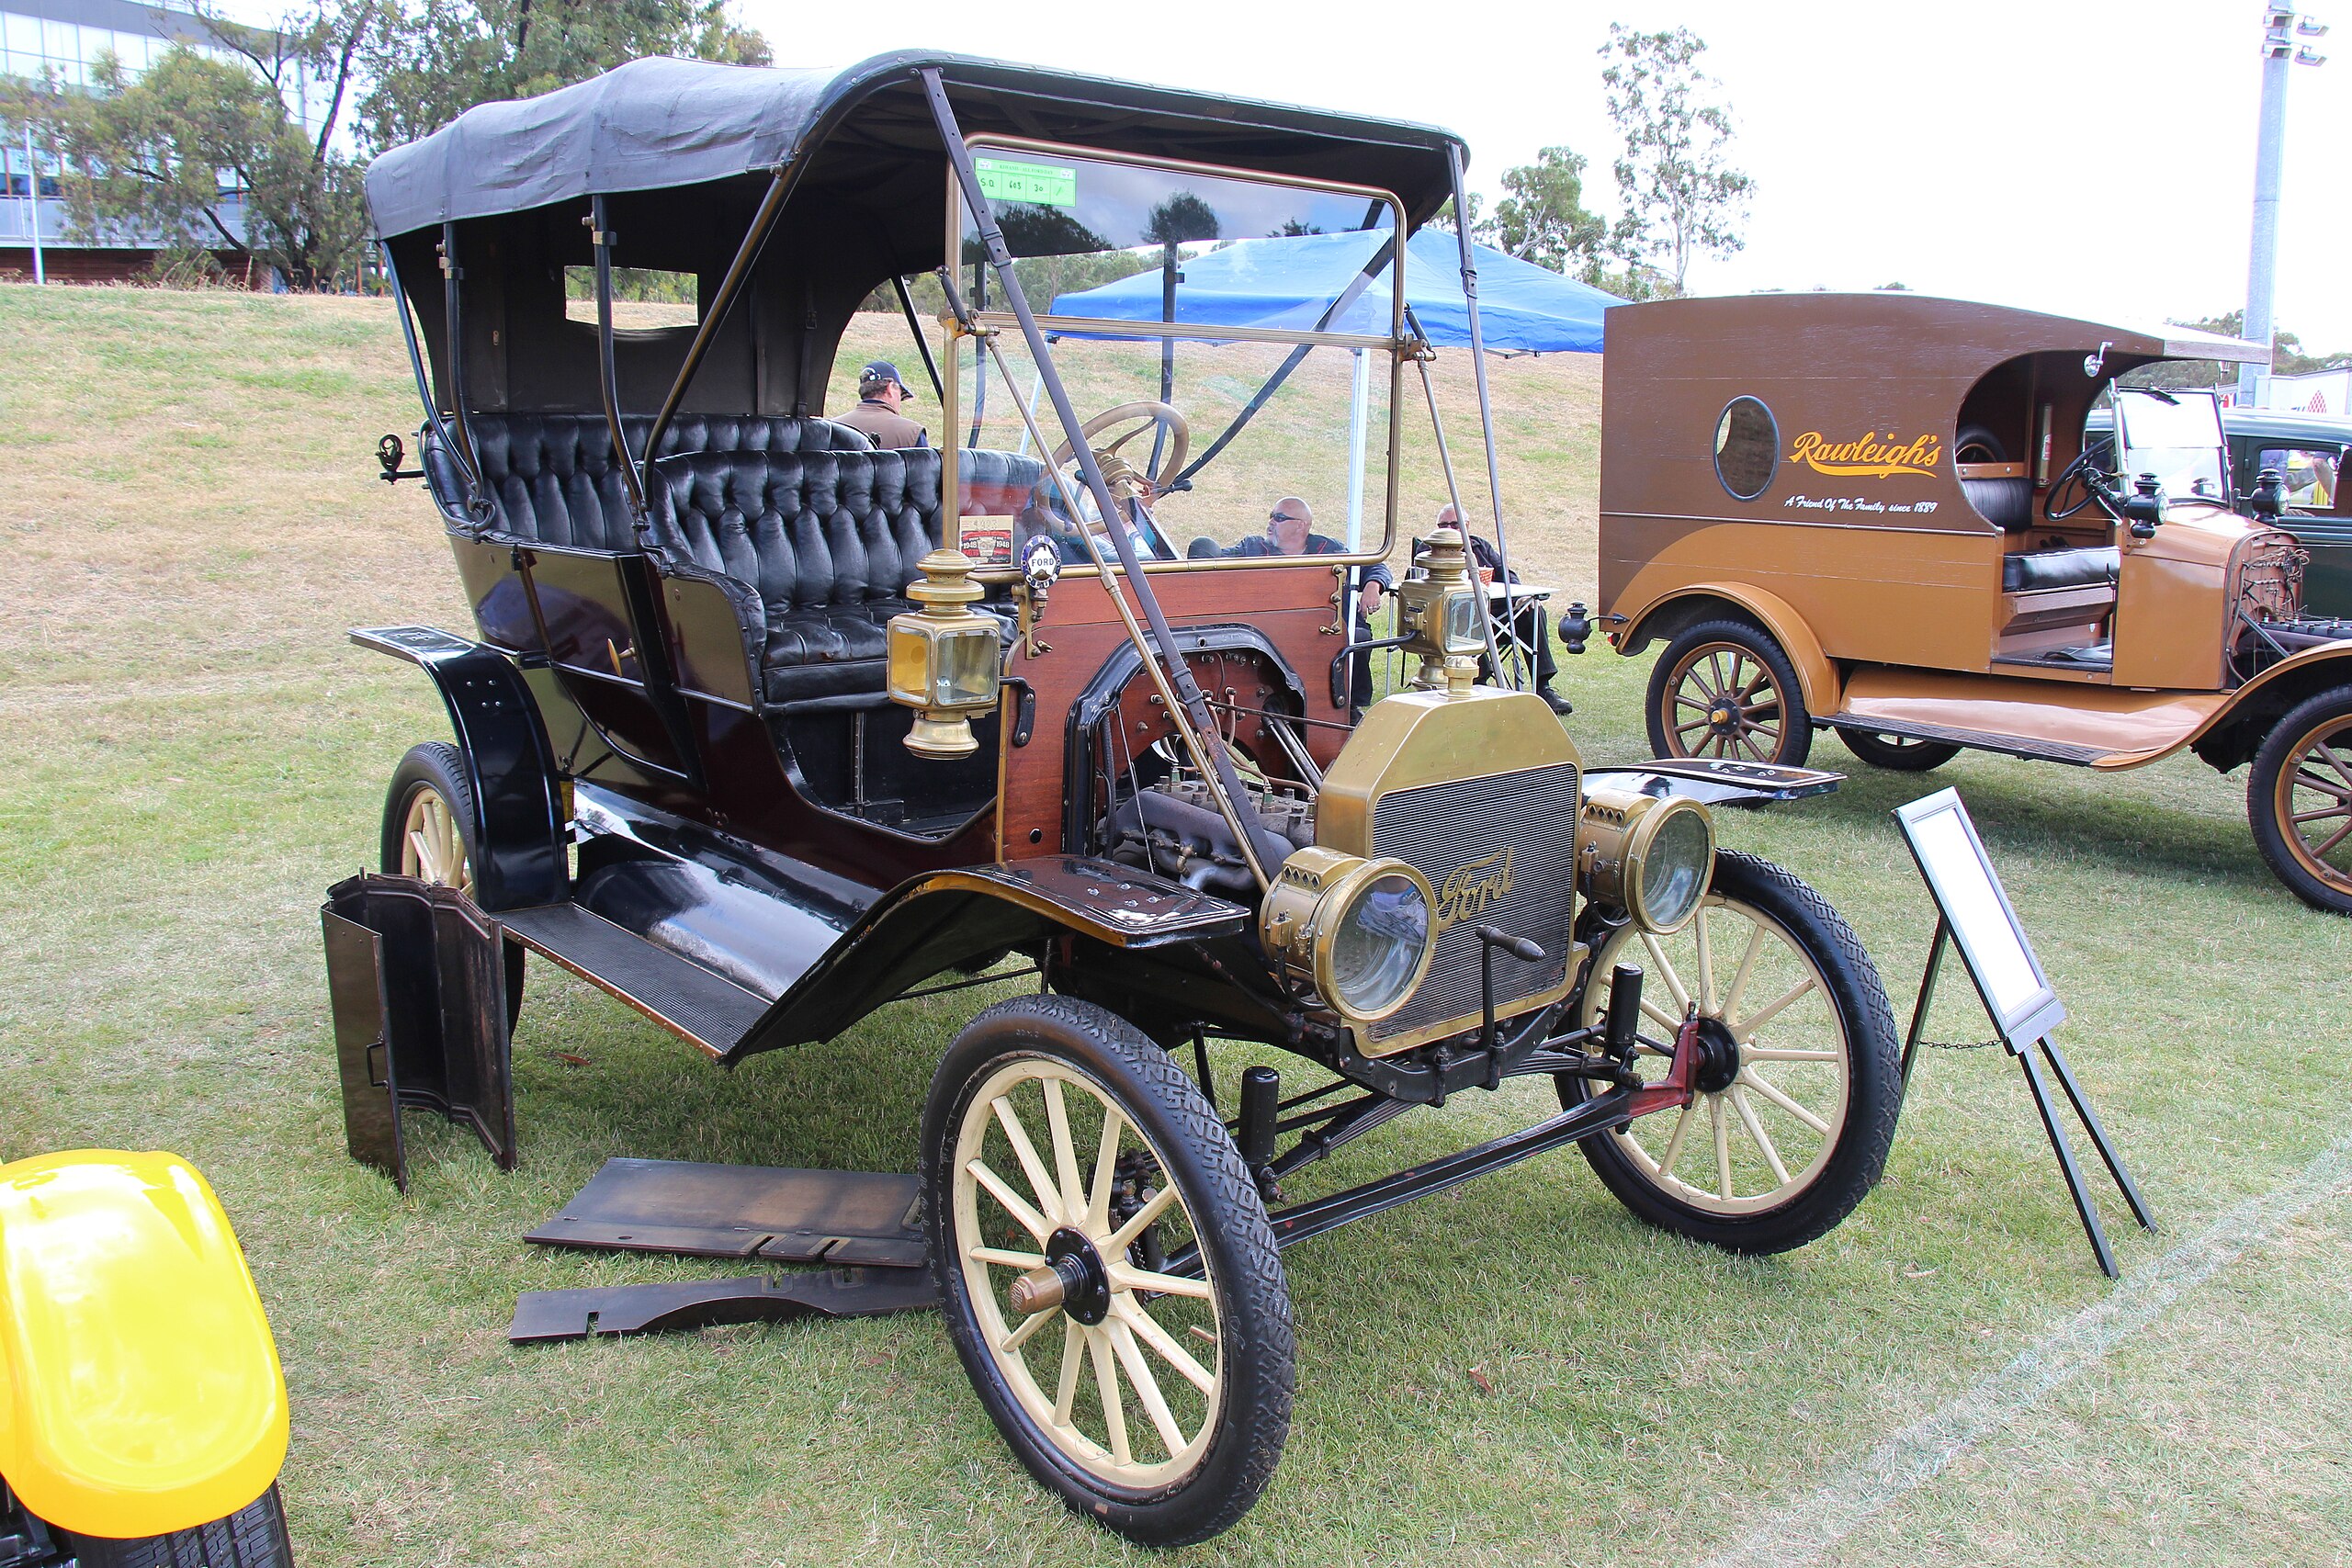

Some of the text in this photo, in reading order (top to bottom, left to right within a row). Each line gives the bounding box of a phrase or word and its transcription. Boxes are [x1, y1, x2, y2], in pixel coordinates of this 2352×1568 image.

[1009, 180, 1022, 190] 603
[1034, 184, 1044, 192] 30
[1789, 431, 1941, 479] Rawleigh's
[1784, 495, 1938, 513] A Friend Of The Family since 1889
[996, 540, 1010, 548] 1948
[1026, 535, 1057, 547] THE
[1031, 558, 1055, 567] FORD
[1438, 844, 1515, 931] Ford
